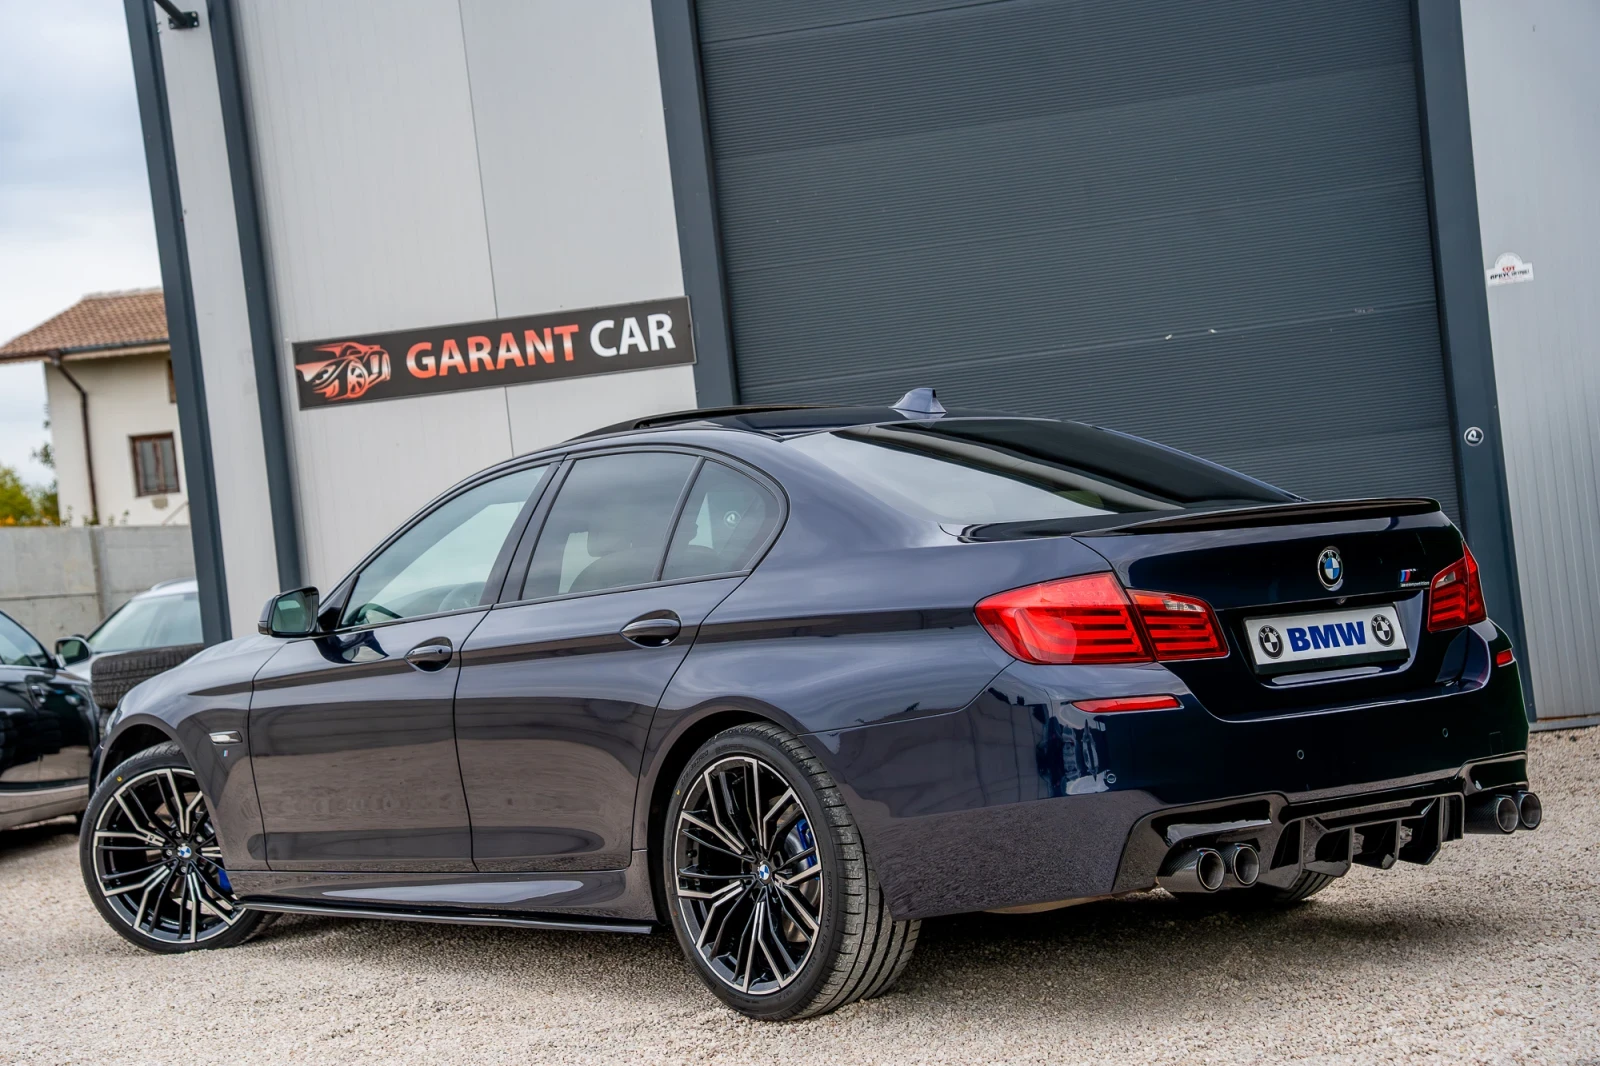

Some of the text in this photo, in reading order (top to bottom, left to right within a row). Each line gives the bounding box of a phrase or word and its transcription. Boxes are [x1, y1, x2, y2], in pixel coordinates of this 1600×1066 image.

[405, 313, 677, 379] GARANT CAR
[1286, 621, 1366, 653] BMW
